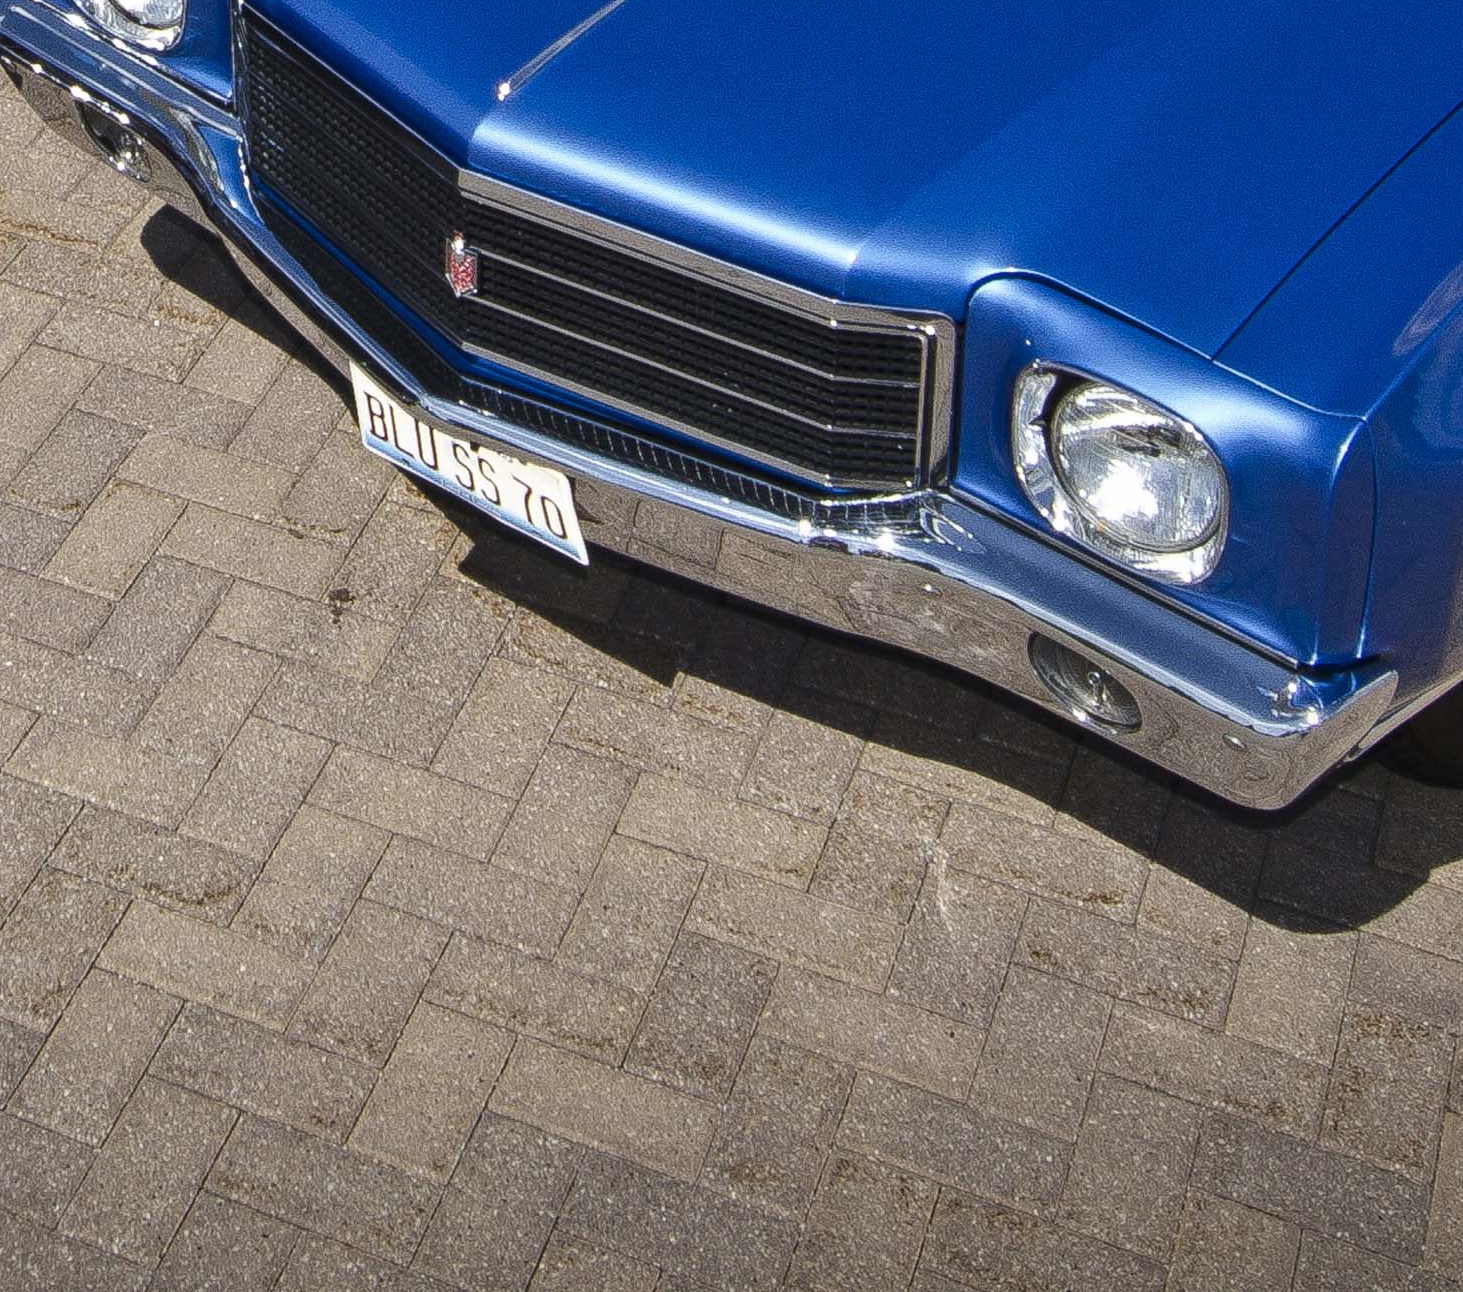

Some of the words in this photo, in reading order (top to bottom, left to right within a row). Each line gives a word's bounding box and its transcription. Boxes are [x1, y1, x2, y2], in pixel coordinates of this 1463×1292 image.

[364, 390, 438, 471] BLU
[453, 441, 501, 506] SS
[512, 475, 568, 539] 70
